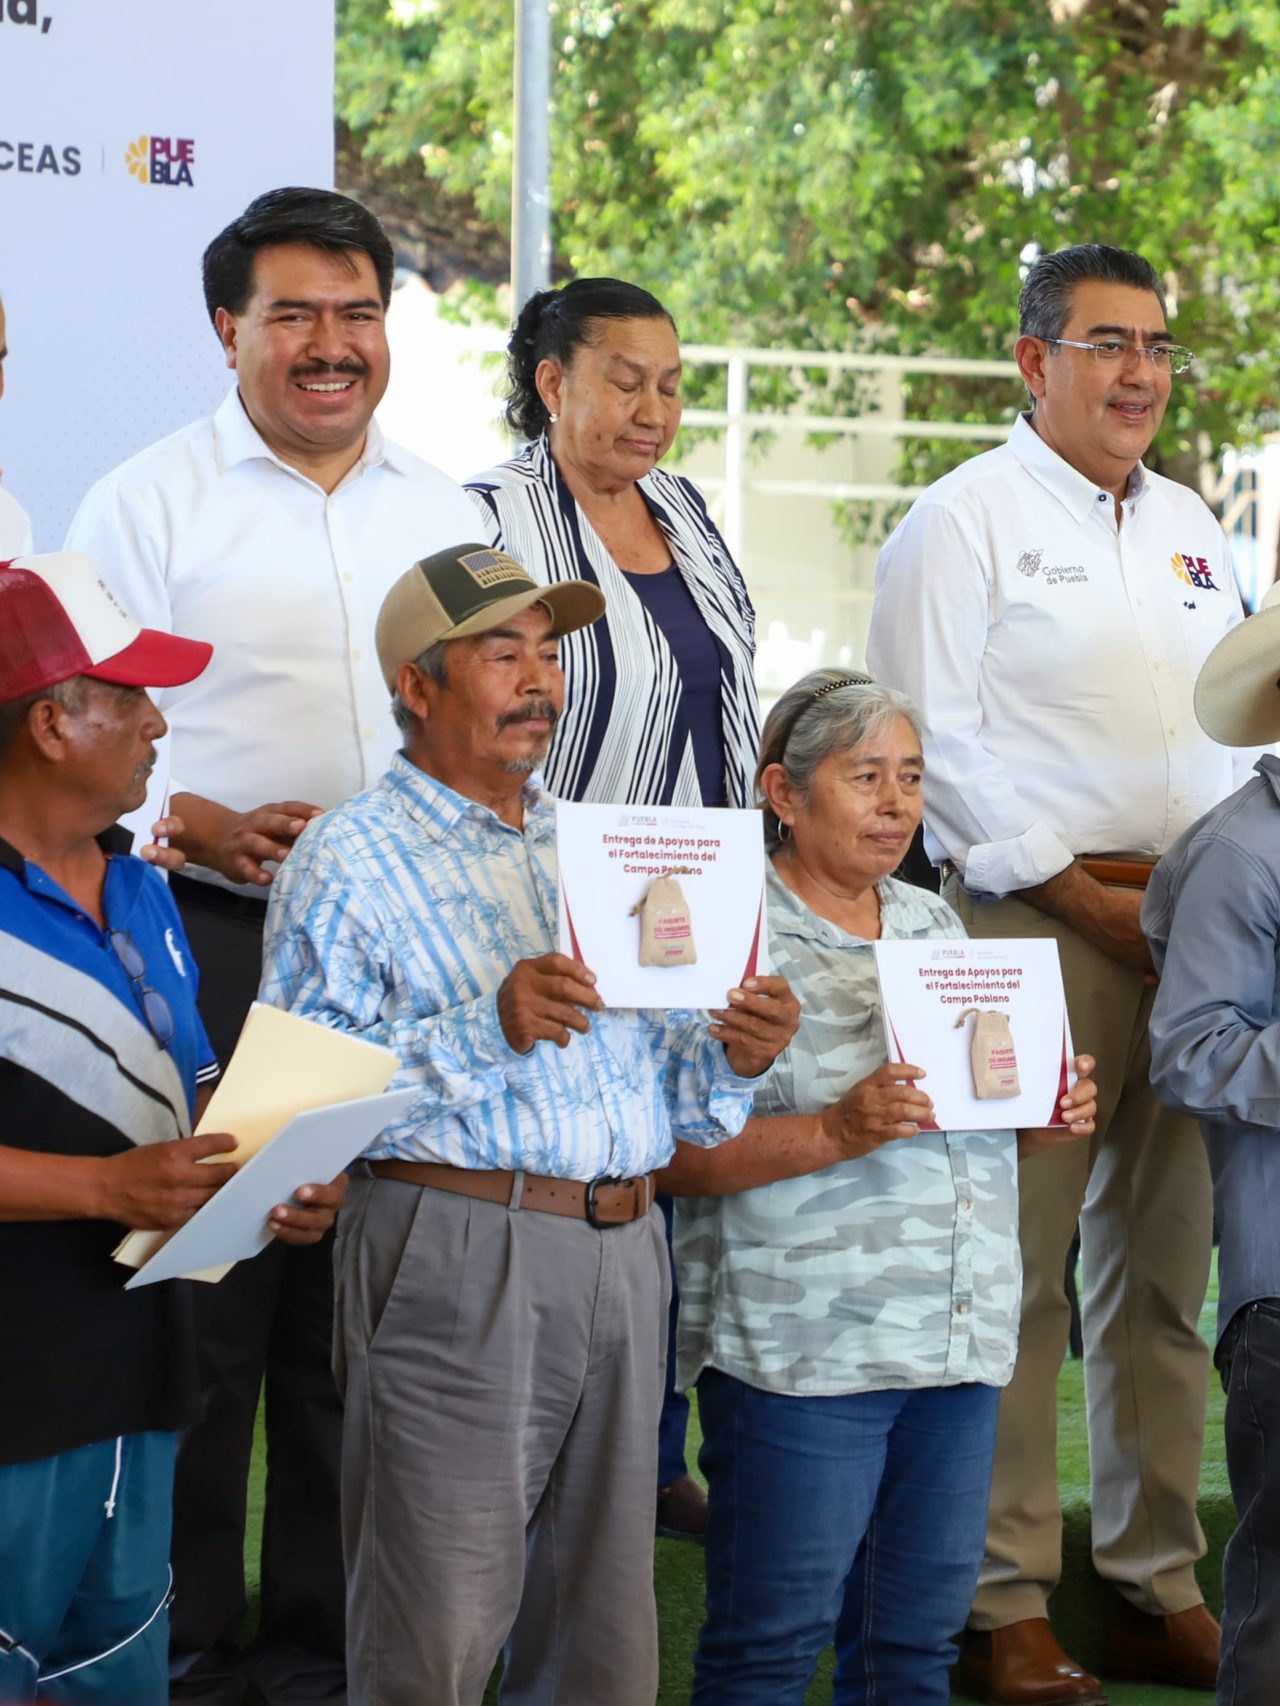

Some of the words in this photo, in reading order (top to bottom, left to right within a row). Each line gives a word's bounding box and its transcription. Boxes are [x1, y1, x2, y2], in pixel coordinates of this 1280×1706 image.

[1041, 565, 1085, 576] Gobierno
[1046, 576, 1058, 585] de
[1059, 573, 1088, 583] Puebla
[603, 835, 642, 847] Entrega
[644, 836, 655, 845] de
[658, 837, 695, 847] Apoyos
[697, 839, 720, 849] para
[609, 850, 617, 858] el
[620, 850, 699, 861] Fortalecimiento
[702, 852, 716, 861] del
[624, 864, 660, 876] Campo
[919, 968, 953, 979] Entrega
[956, 968, 966, 976] de
[968, 968, 1000, 978] Apoyos
[1003, 968, 1022, 978] para
[926, 982, 933, 990] el
[935, 982, 1005, 990] Fortalecimiento
[1007, 981, 1020, 989] del
[941, 995, 972, 1006] Campo
[974, 995, 1009, 1003] Poblano
